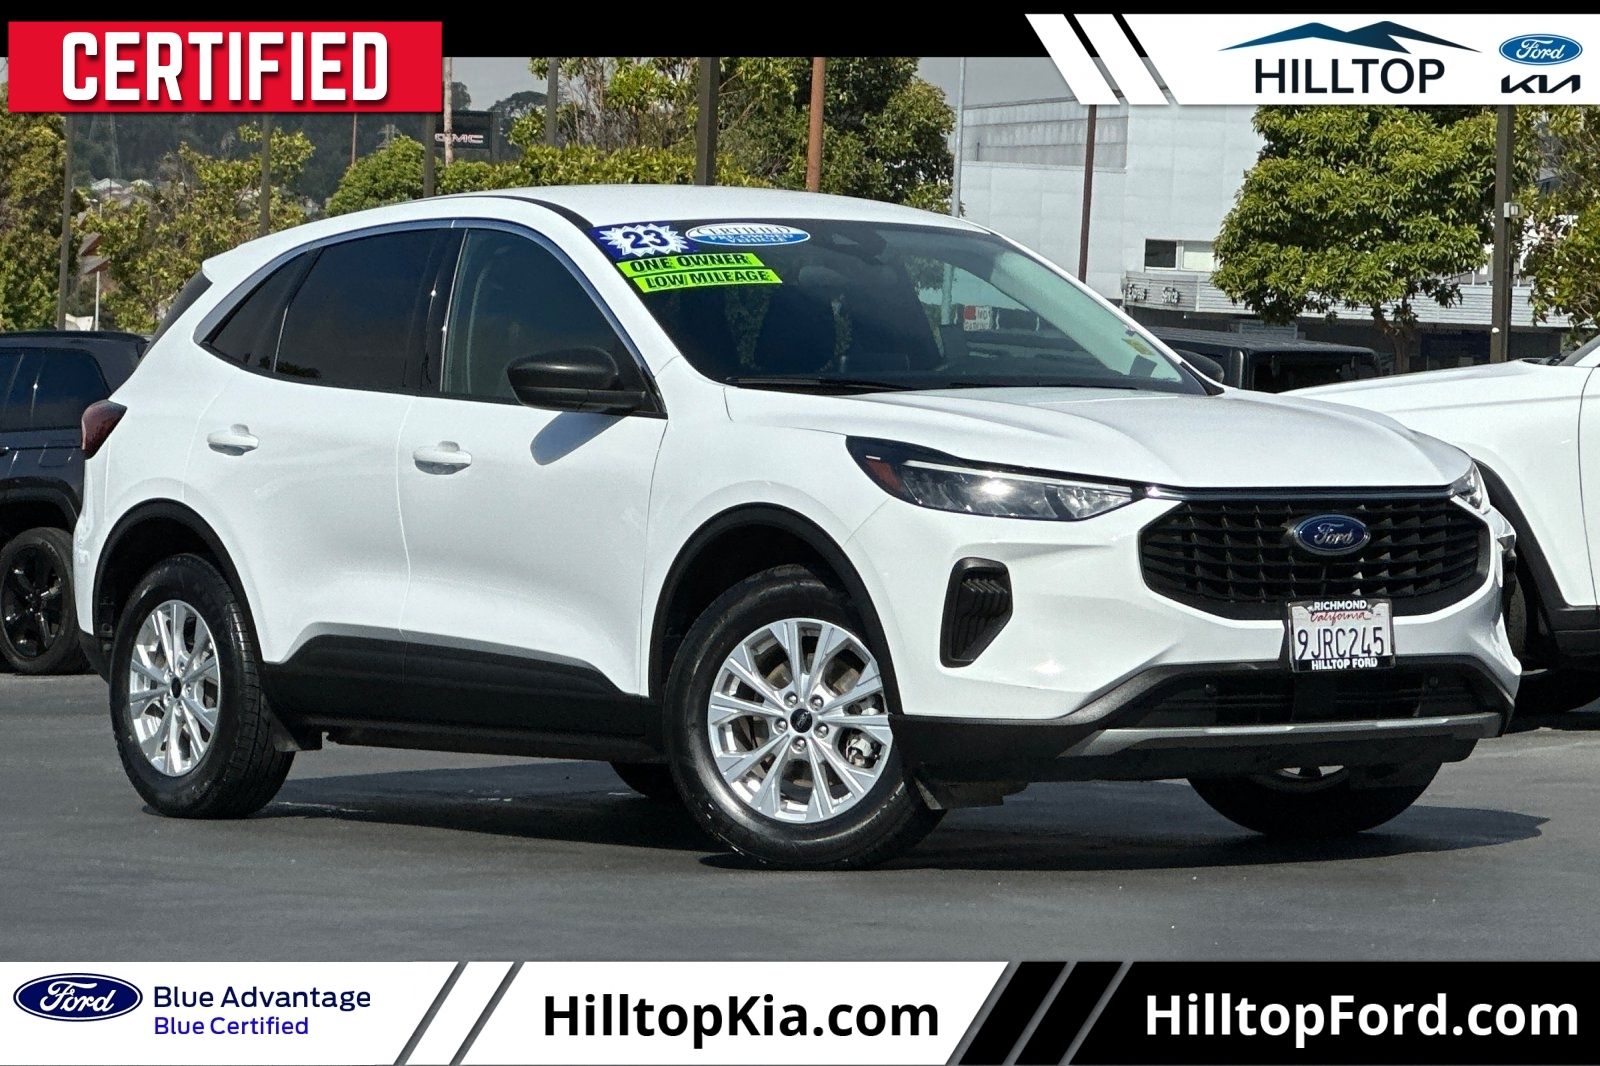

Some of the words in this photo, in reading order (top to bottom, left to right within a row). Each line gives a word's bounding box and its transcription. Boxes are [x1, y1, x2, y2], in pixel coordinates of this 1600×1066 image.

[622, 230, 668, 249] 23
[630, 260, 672, 272] ONE
[677, 254, 748, 268] OWNER
[645, 275, 687, 289] LOW
[691, 270, 769, 284] MILEAGE
[1314, 523, 1355, 545] Ford
[1314, 600, 1367, 611] RICHMOND
[1310, 610, 1372, 626] California
[1297, 626, 1384, 660] 9JRC245
[1311, 658, 1351, 671] HILLTOP
[1352, 657, 1379, 669] FORD
